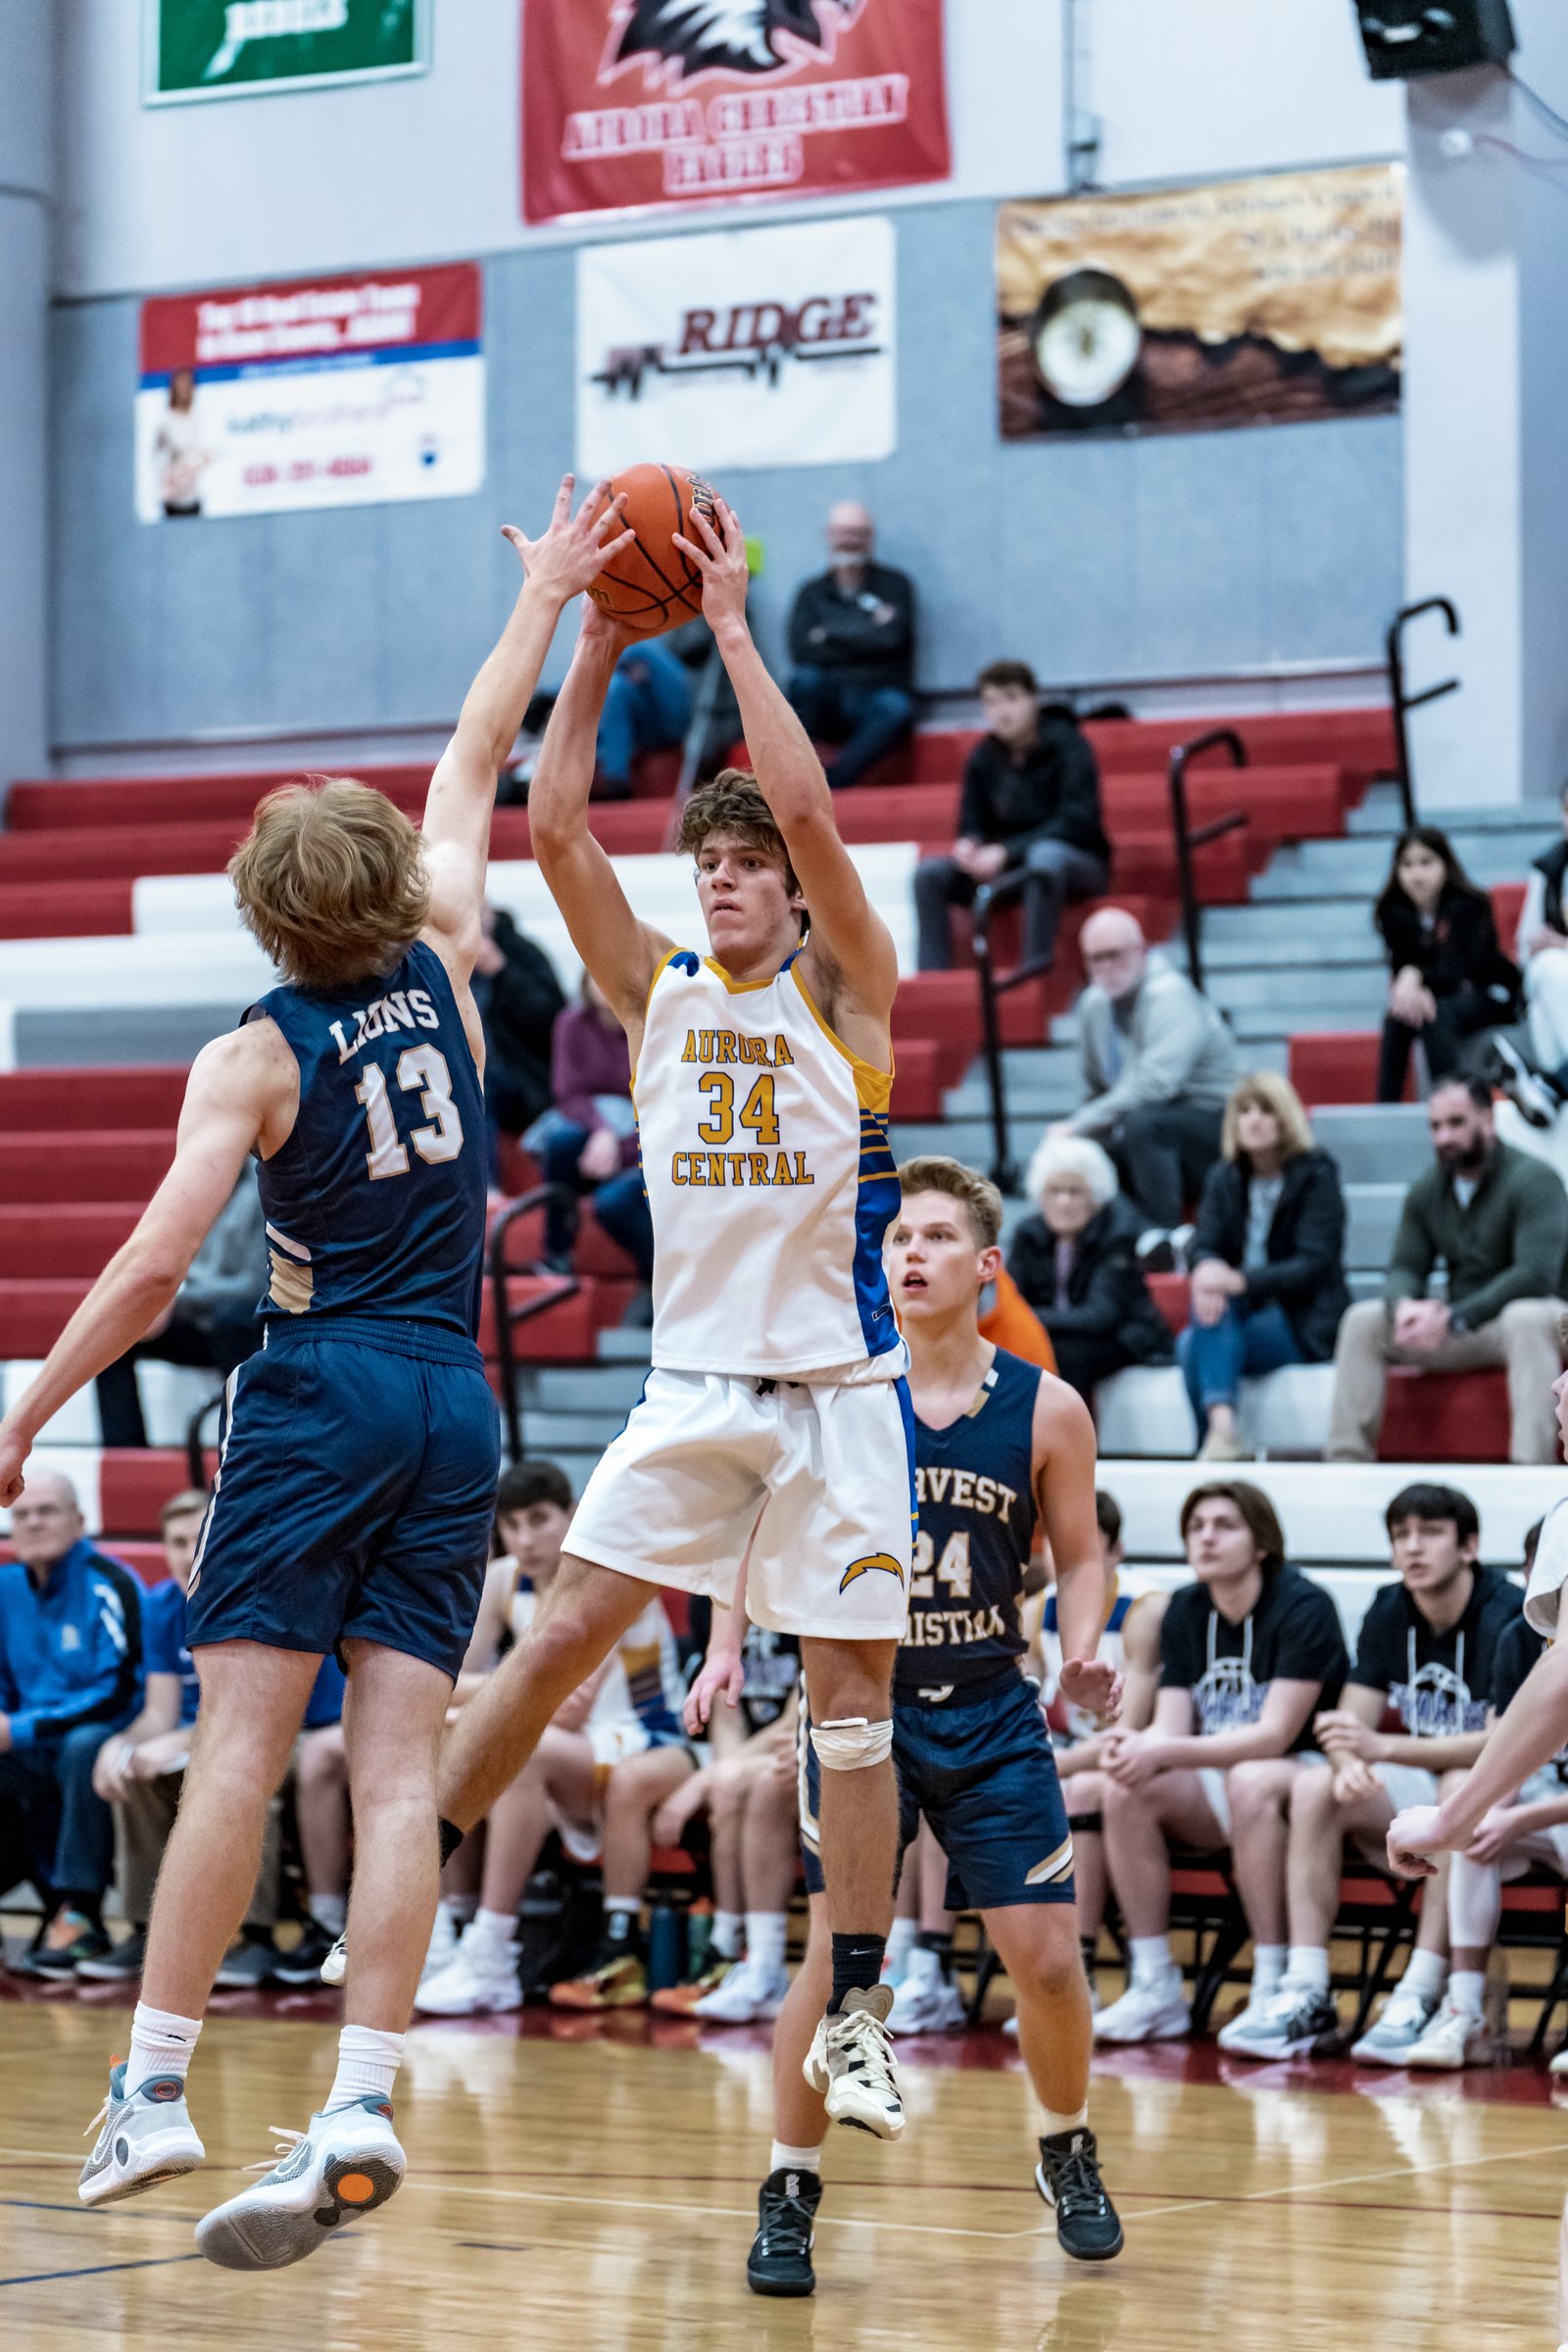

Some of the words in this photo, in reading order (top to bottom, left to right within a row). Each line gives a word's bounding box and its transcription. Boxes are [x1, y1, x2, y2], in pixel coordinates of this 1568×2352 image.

[678, 292, 875, 355] RIDGE
[328, 989, 440, 1065] LIONS
[681, 1029, 795, 1067] AURORA
[354, 1043, 465, 1181] 13
[698, 1071, 780, 1145] 34
[671, 1152, 814, 1186] CENTRAL
[909, 1530, 972, 1598] 24
